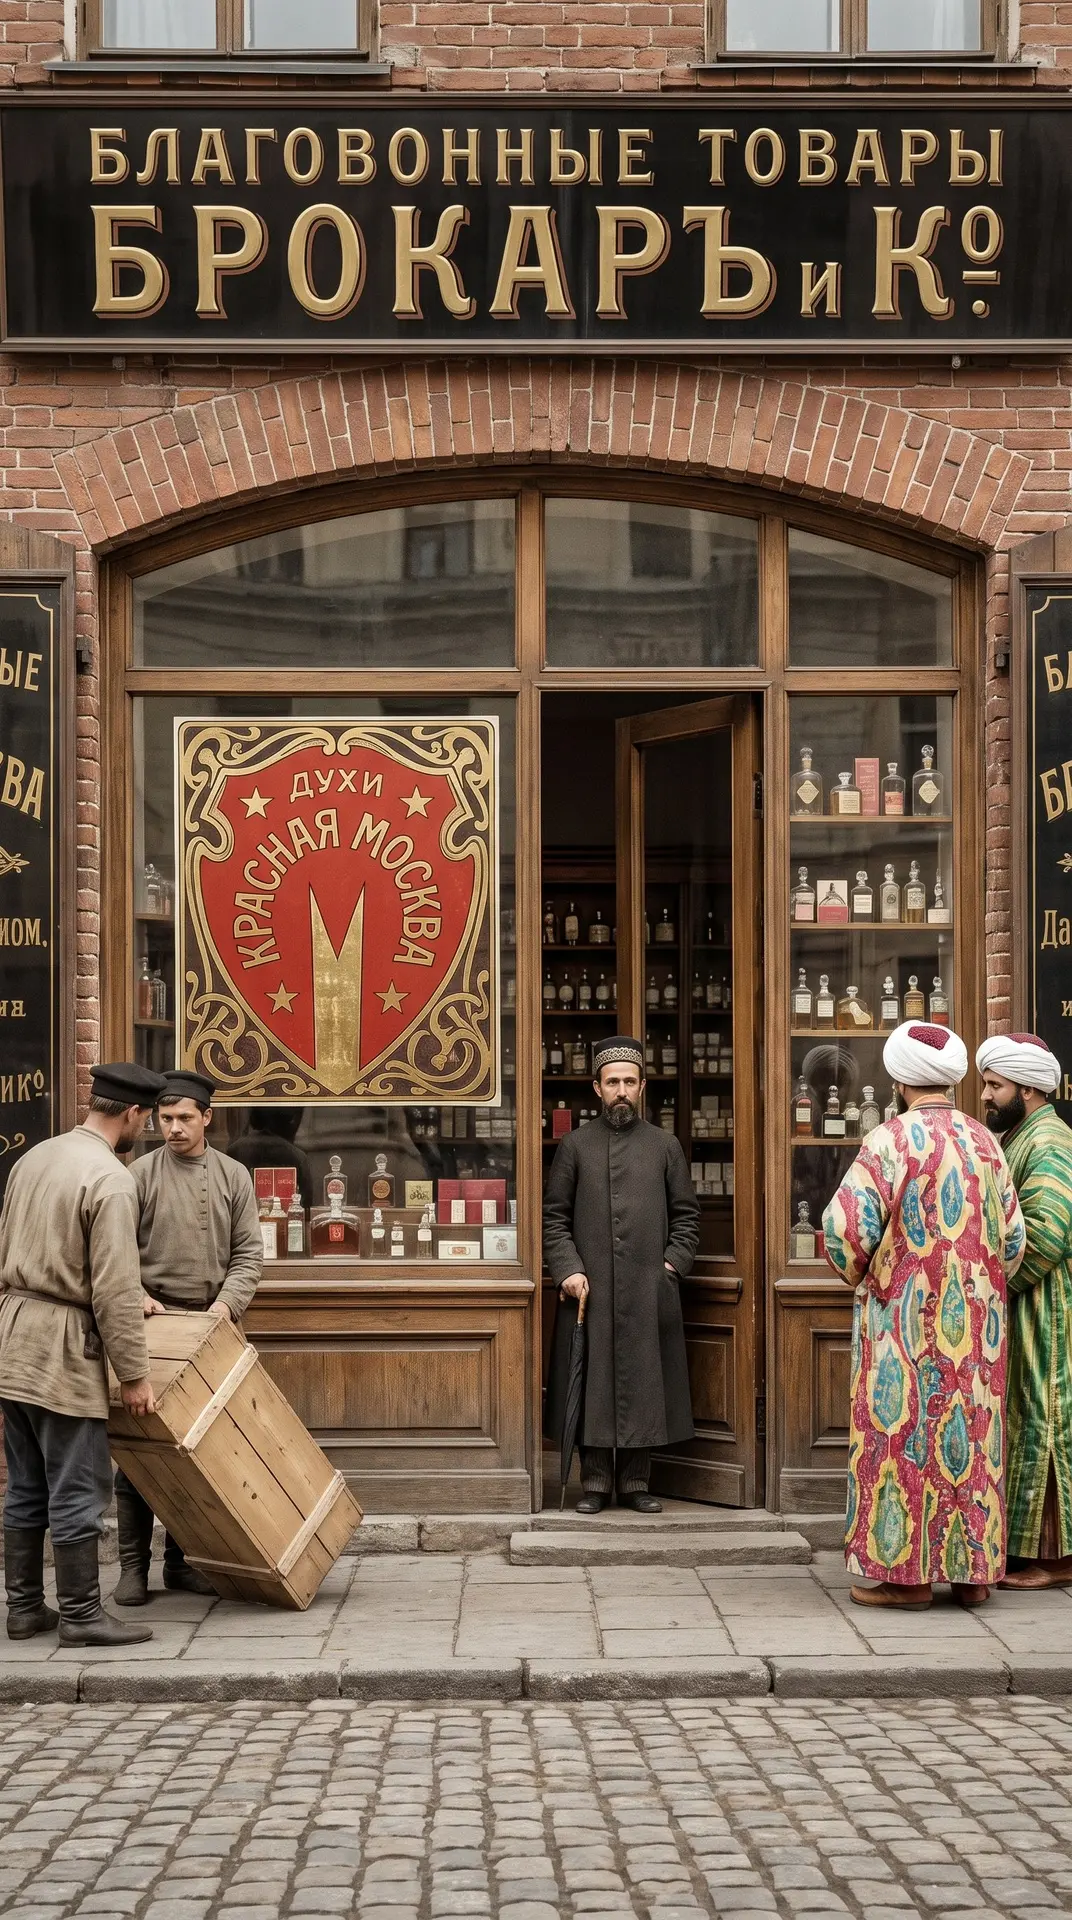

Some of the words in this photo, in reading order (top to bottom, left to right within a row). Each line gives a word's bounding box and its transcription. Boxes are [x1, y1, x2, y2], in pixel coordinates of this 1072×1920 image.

[89, 127, 655, 186] БЛАГОВОННЫЕ
[698, 127, 1005, 186] ТОВАРЫ
[90, 203, 777, 321] БРОКАРЪ
[288, 767, 384, 803] ДУХИ
[233, 808, 341, 970] КРАСНАЯ
[350, 812, 443, 968] МОСКВА
